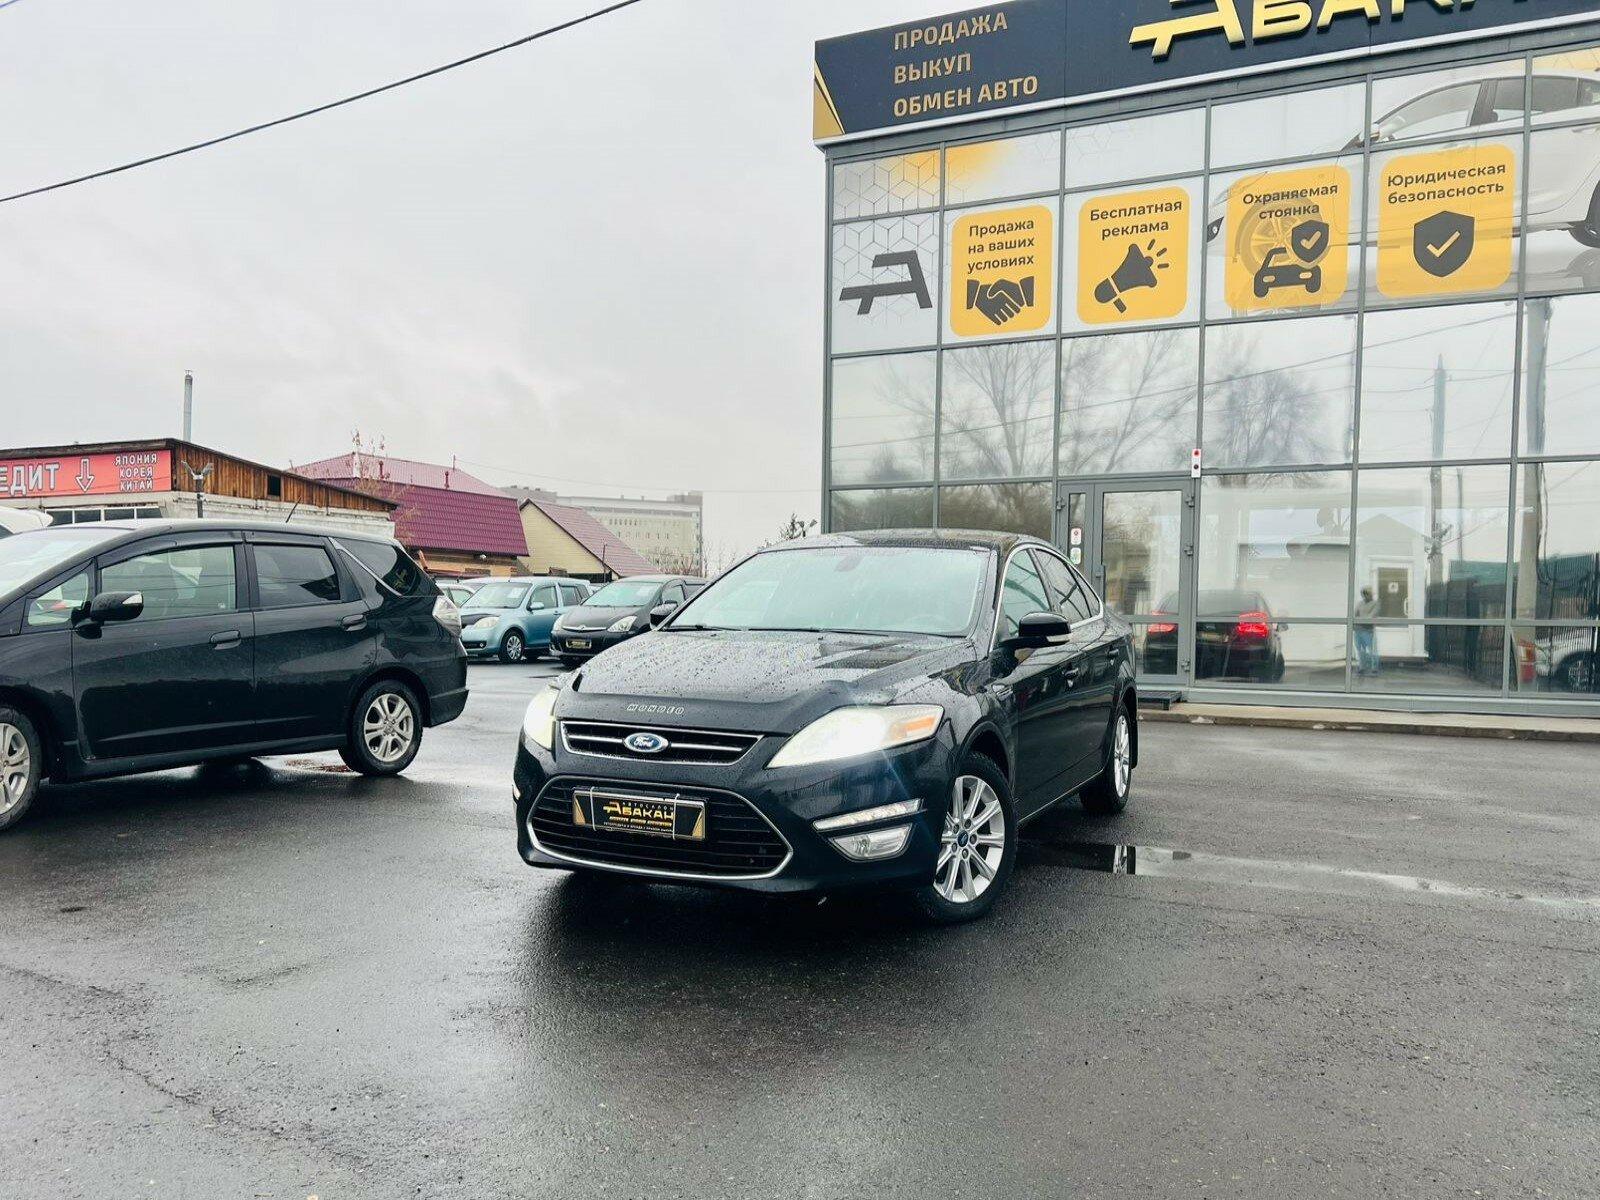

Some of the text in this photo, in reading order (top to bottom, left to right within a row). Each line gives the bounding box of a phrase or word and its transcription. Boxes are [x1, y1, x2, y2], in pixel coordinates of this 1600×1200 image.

[894, 12, 1009, 50] ПРОДАЖА
[894, 53, 972, 84] ВЫКУП
[893, 75, 1038, 117] ОБМЕН АВТО
[1387, 164, 1507, 188] Юридическая
[1242, 184, 1339, 205] Охраняемая
[1387, 182, 1505, 204] безопасность
[1090, 201, 1183, 221] Бесплатная
[1258, 204, 1320, 220] стоянка
[969, 219, 1035, 237] Продажа
[1101, 220, 1170, 241] реклама
[968, 237, 1035, 255] на ваших
[967, 255, 1035, 275] условиях
[115, 453, 157, 466] ЯПОНИЯ
[119, 466, 153, 478] КОРЕЯ
[120, 478, 153, 491] КИТАЙ
[603, 802, 674, 820] АБАКАН
